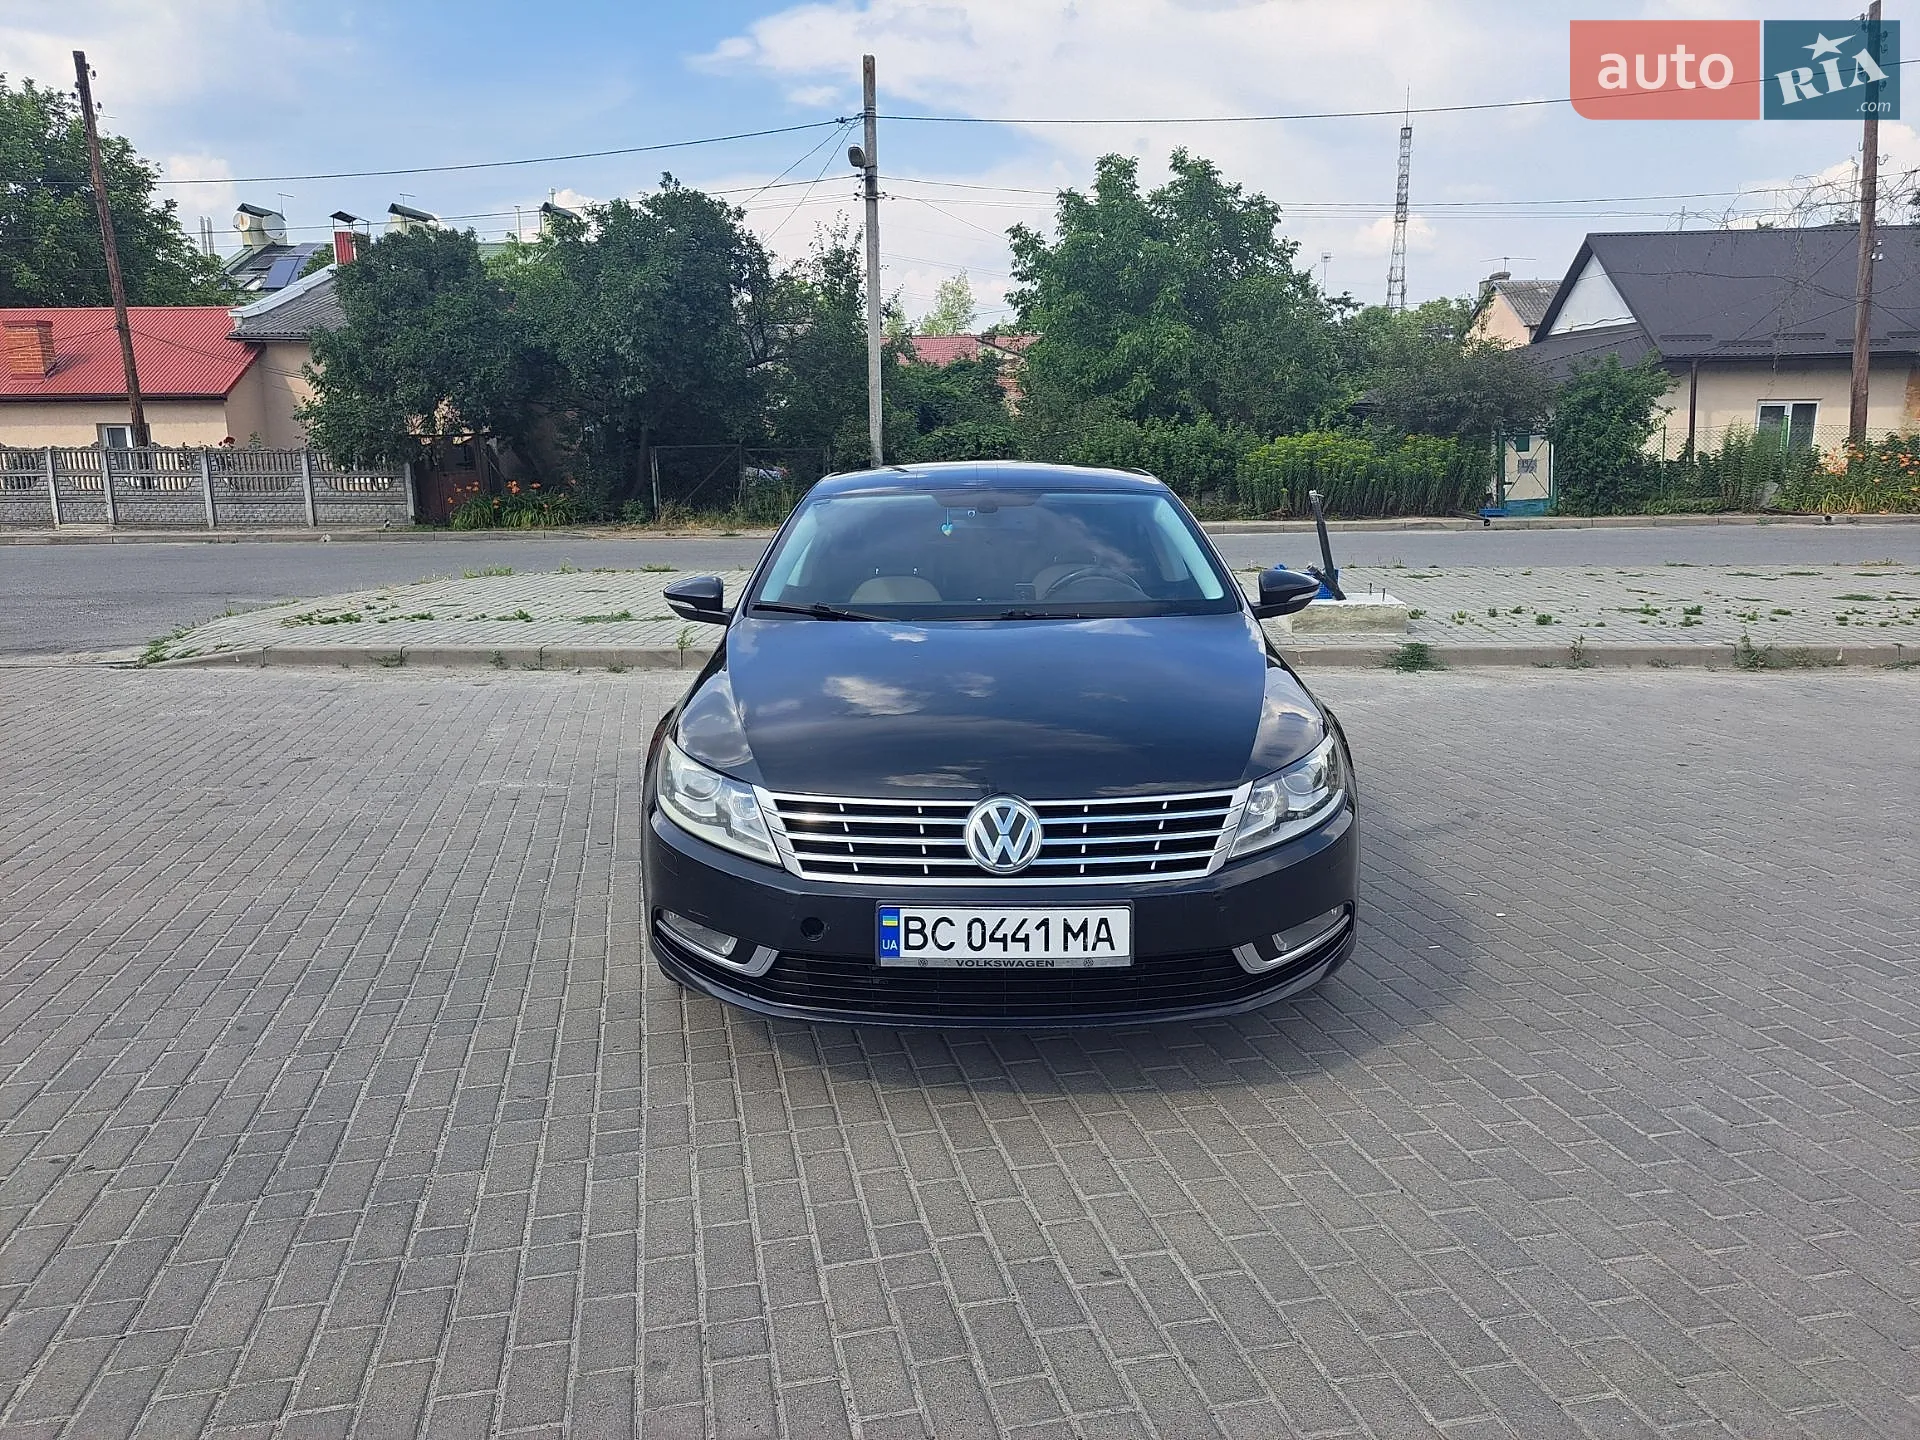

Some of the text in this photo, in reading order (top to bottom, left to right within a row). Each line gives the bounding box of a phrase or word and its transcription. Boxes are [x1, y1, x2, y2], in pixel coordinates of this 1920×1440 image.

[903, 915, 1116, 953] BC 0441 MA
[882, 939, 898, 951] UA
[955, 959, 1055, 968] VOLKSWAGEN
